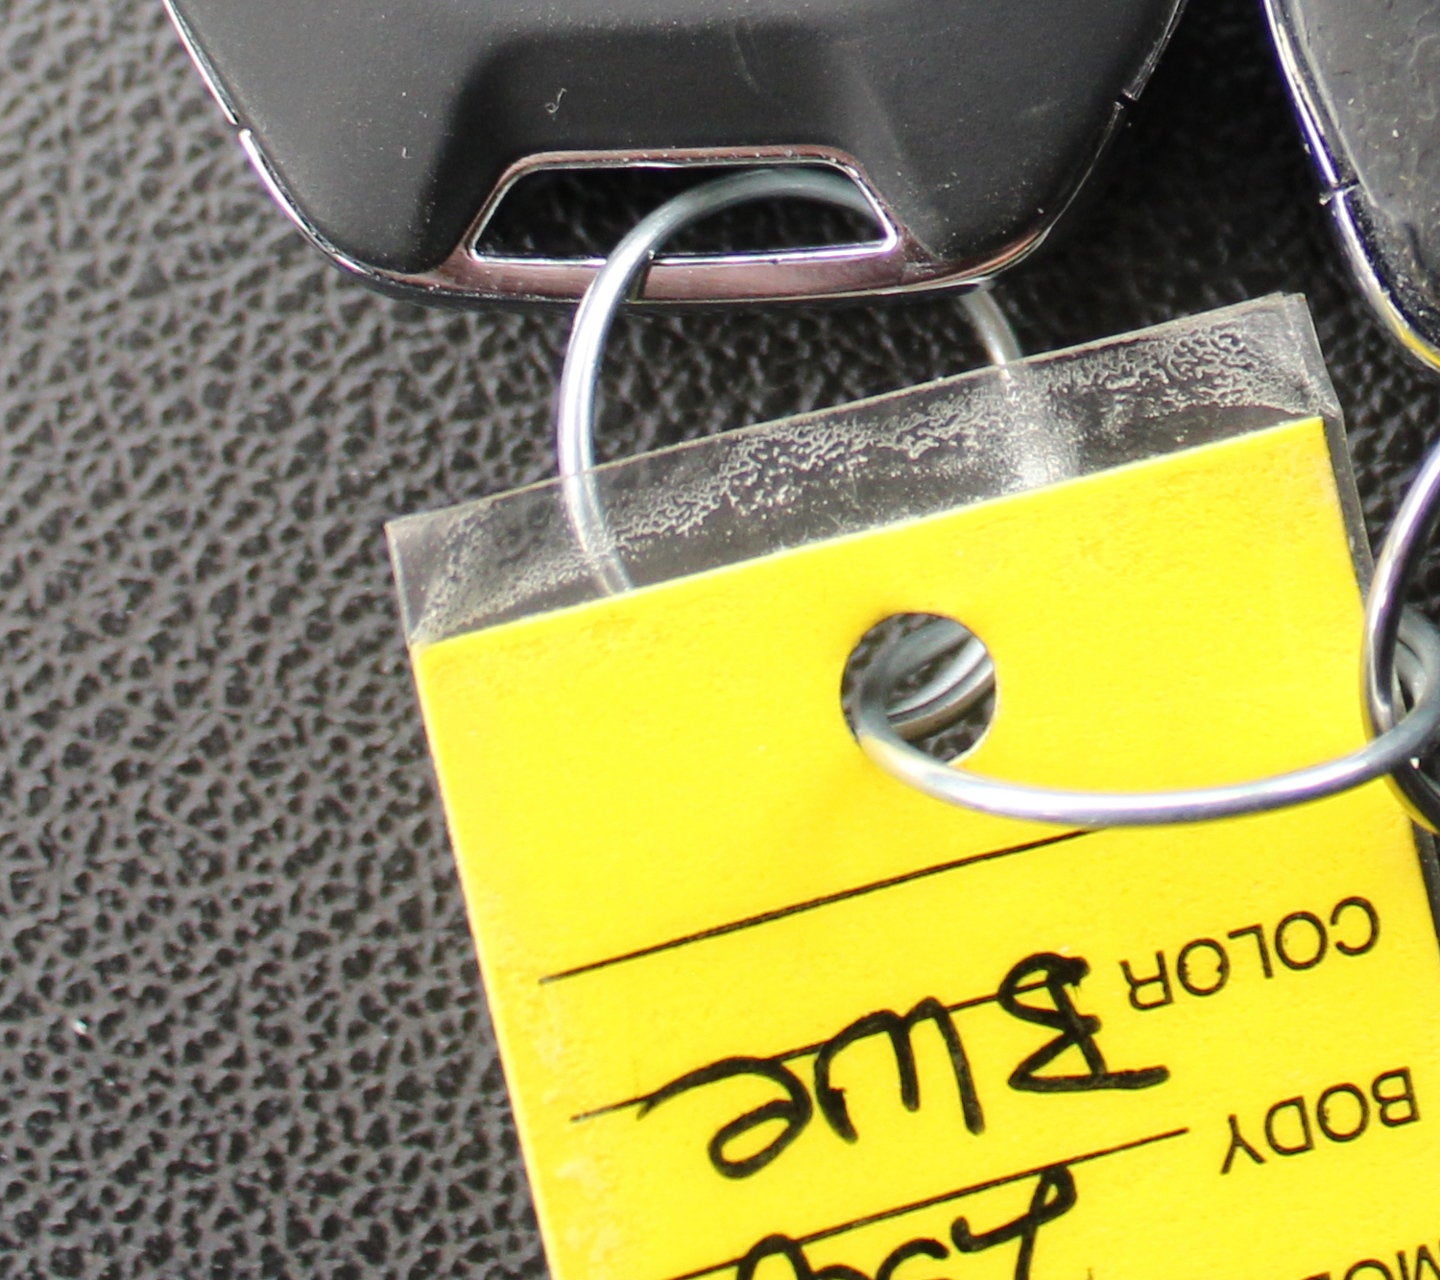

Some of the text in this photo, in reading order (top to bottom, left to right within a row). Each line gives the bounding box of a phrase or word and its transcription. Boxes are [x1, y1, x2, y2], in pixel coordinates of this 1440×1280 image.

[1119, 896, 1380, 1010] COLOR
[637, 952, 1169, 1179] Blue
[1220, 1066, 1420, 1175] BODY
